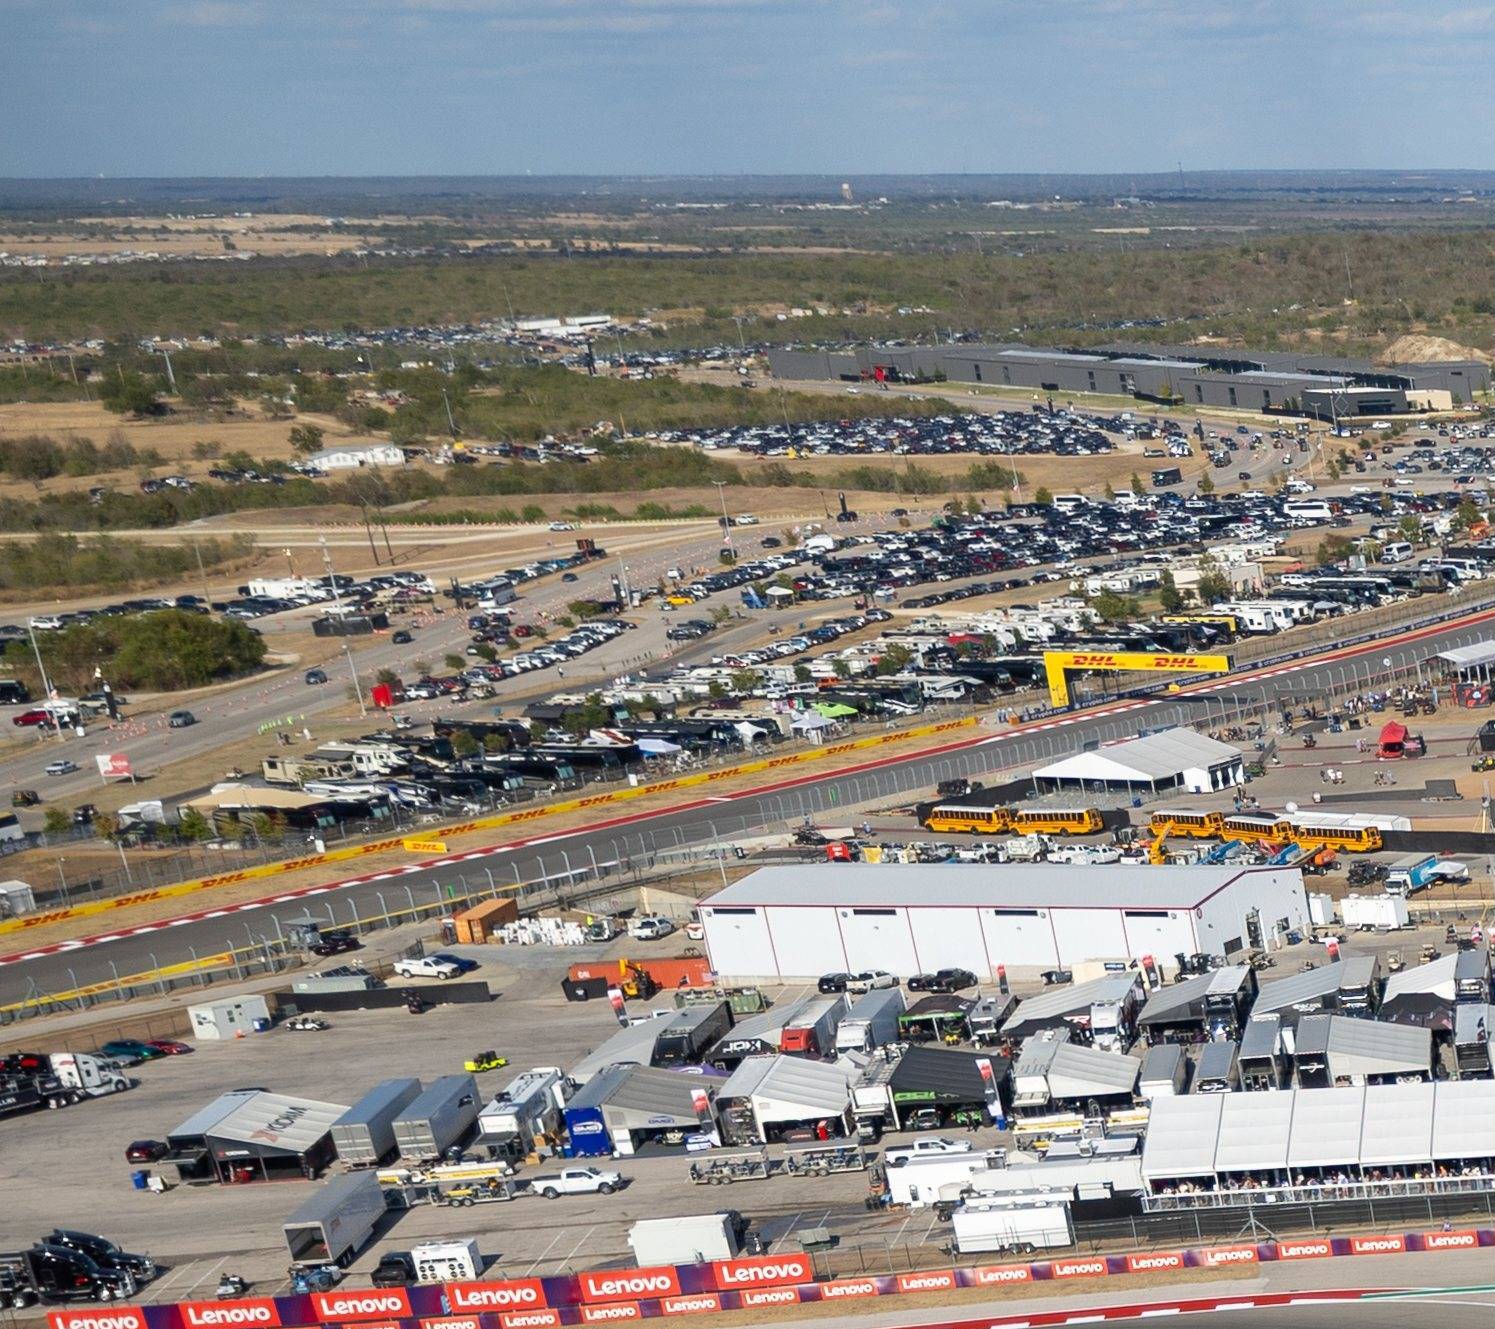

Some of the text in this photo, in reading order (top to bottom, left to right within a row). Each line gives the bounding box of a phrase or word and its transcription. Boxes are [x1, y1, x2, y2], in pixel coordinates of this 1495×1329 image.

[1072, 655, 1117, 667] DHL
[1154, 657, 1199, 669] DHL
[935, 721, 964, 731] DHL
[882, 732, 914, 743] DHL
[827, 744, 857, 755] DHL
[769, 756, 801, 767] DHL
[645, 782, 679, 794] DHL
[579, 795, 615, 808] DHL
[510, 808, 549, 822] DHL
[438, 823, 477, 837] DHL
[283, 855, 327, 871] DHL
[115, 891, 162, 908] DHL
[23, 910, 72, 927] DHL
[1353, 1238, 1403, 1253] Lenovo
[1427, 1233, 1476, 1247] Lenovo
[1130, 1256, 1181, 1271] Lenovo
[1205, 1249, 1256, 1264] Lenovo
[722, 1260, 804, 1285] Lenovo
[979, 1268, 1029, 1284] Lenovo
[588, 1273, 671, 1297] Lenovo
[900, 1274, 952, 1290] Lenovo
[453, 1285, 537, 1308] Lenovo
[745, 1289, 796, 1305] Lenovo
[320, 1294, 403, 1318] Lenovo
[665, 1297, 716, 1313] Lenovo
[188, 1303, 272, 1327] Lenovo
[505, 1312, 556, 1328] Lenovo
